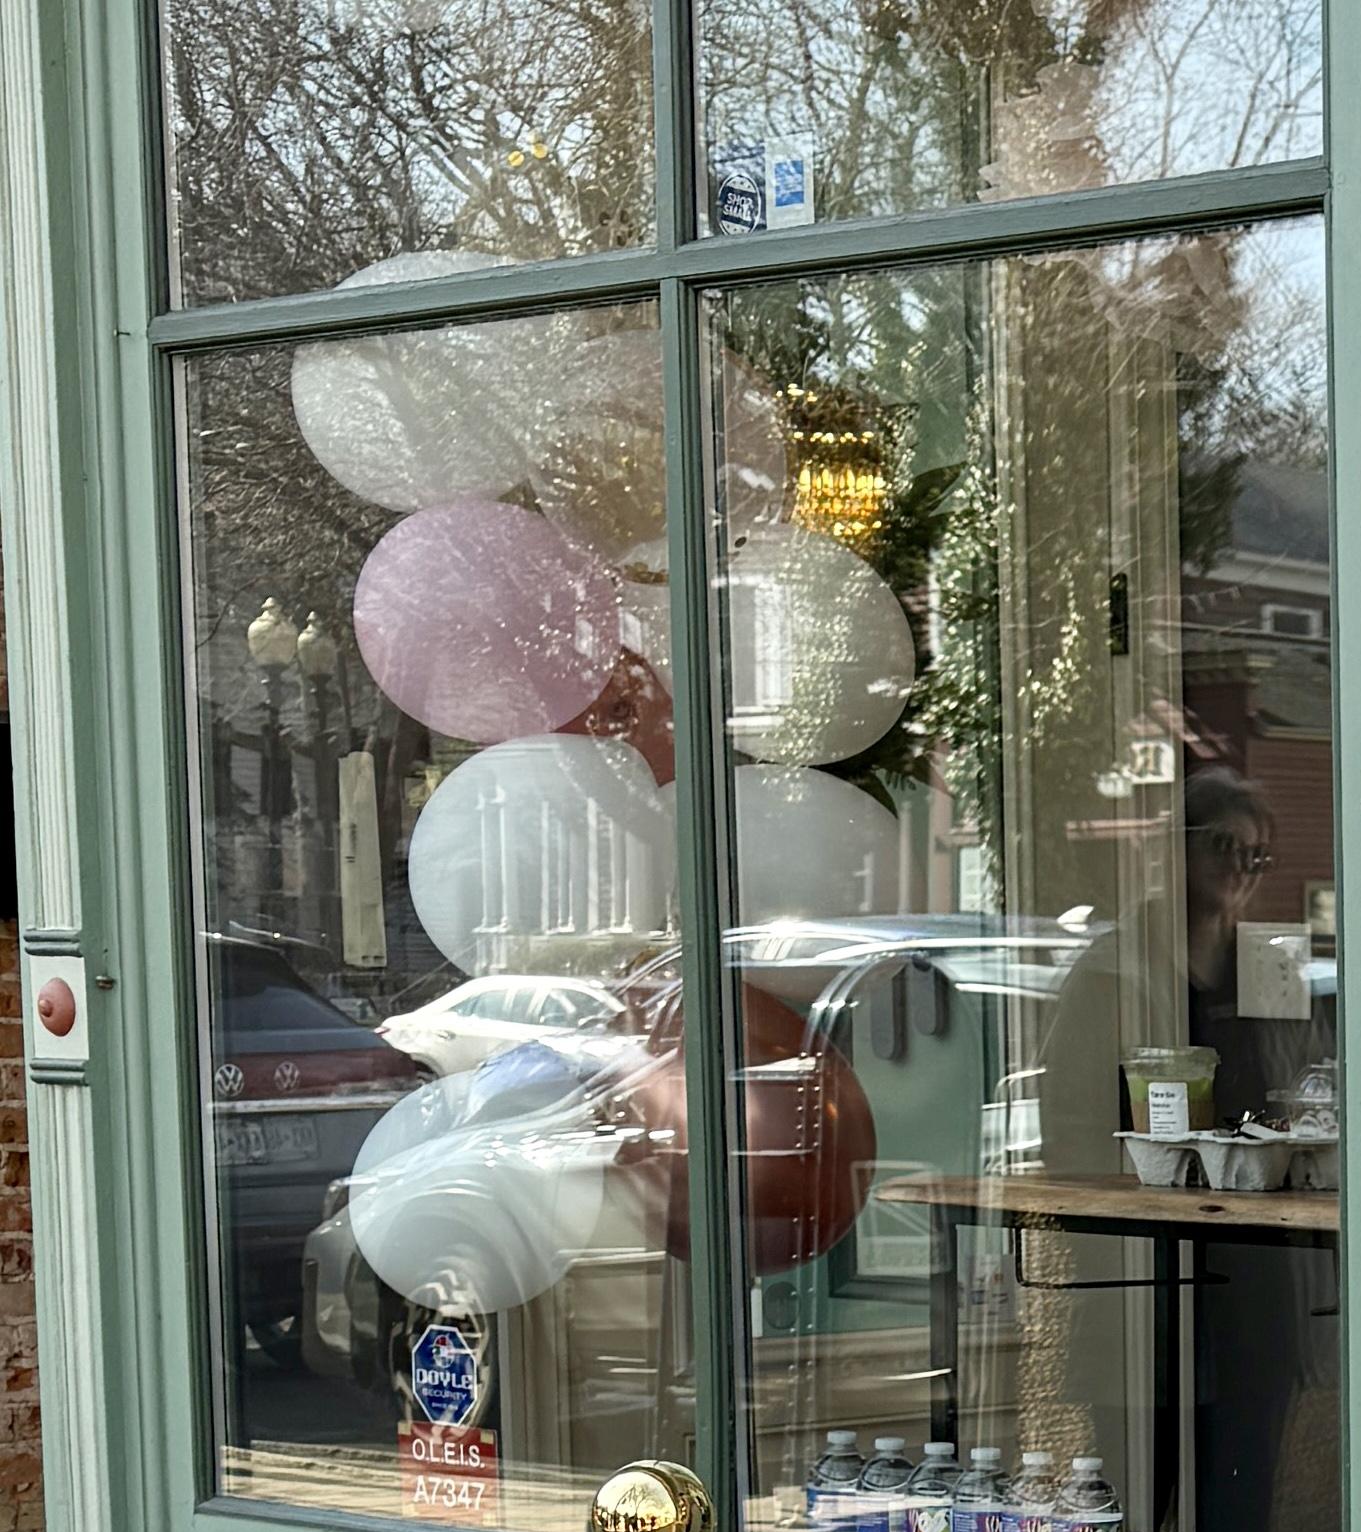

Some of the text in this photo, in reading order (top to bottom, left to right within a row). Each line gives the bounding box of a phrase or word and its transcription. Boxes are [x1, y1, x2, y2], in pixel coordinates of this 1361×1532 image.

[416, 1368, 473, 1390] DOYLE
[422, 1387, 468, 1400] SECURITY
[412, 1438, 487, 1469] O.L.E.I.S.
[413, 1475, 485, 1511] A7347
